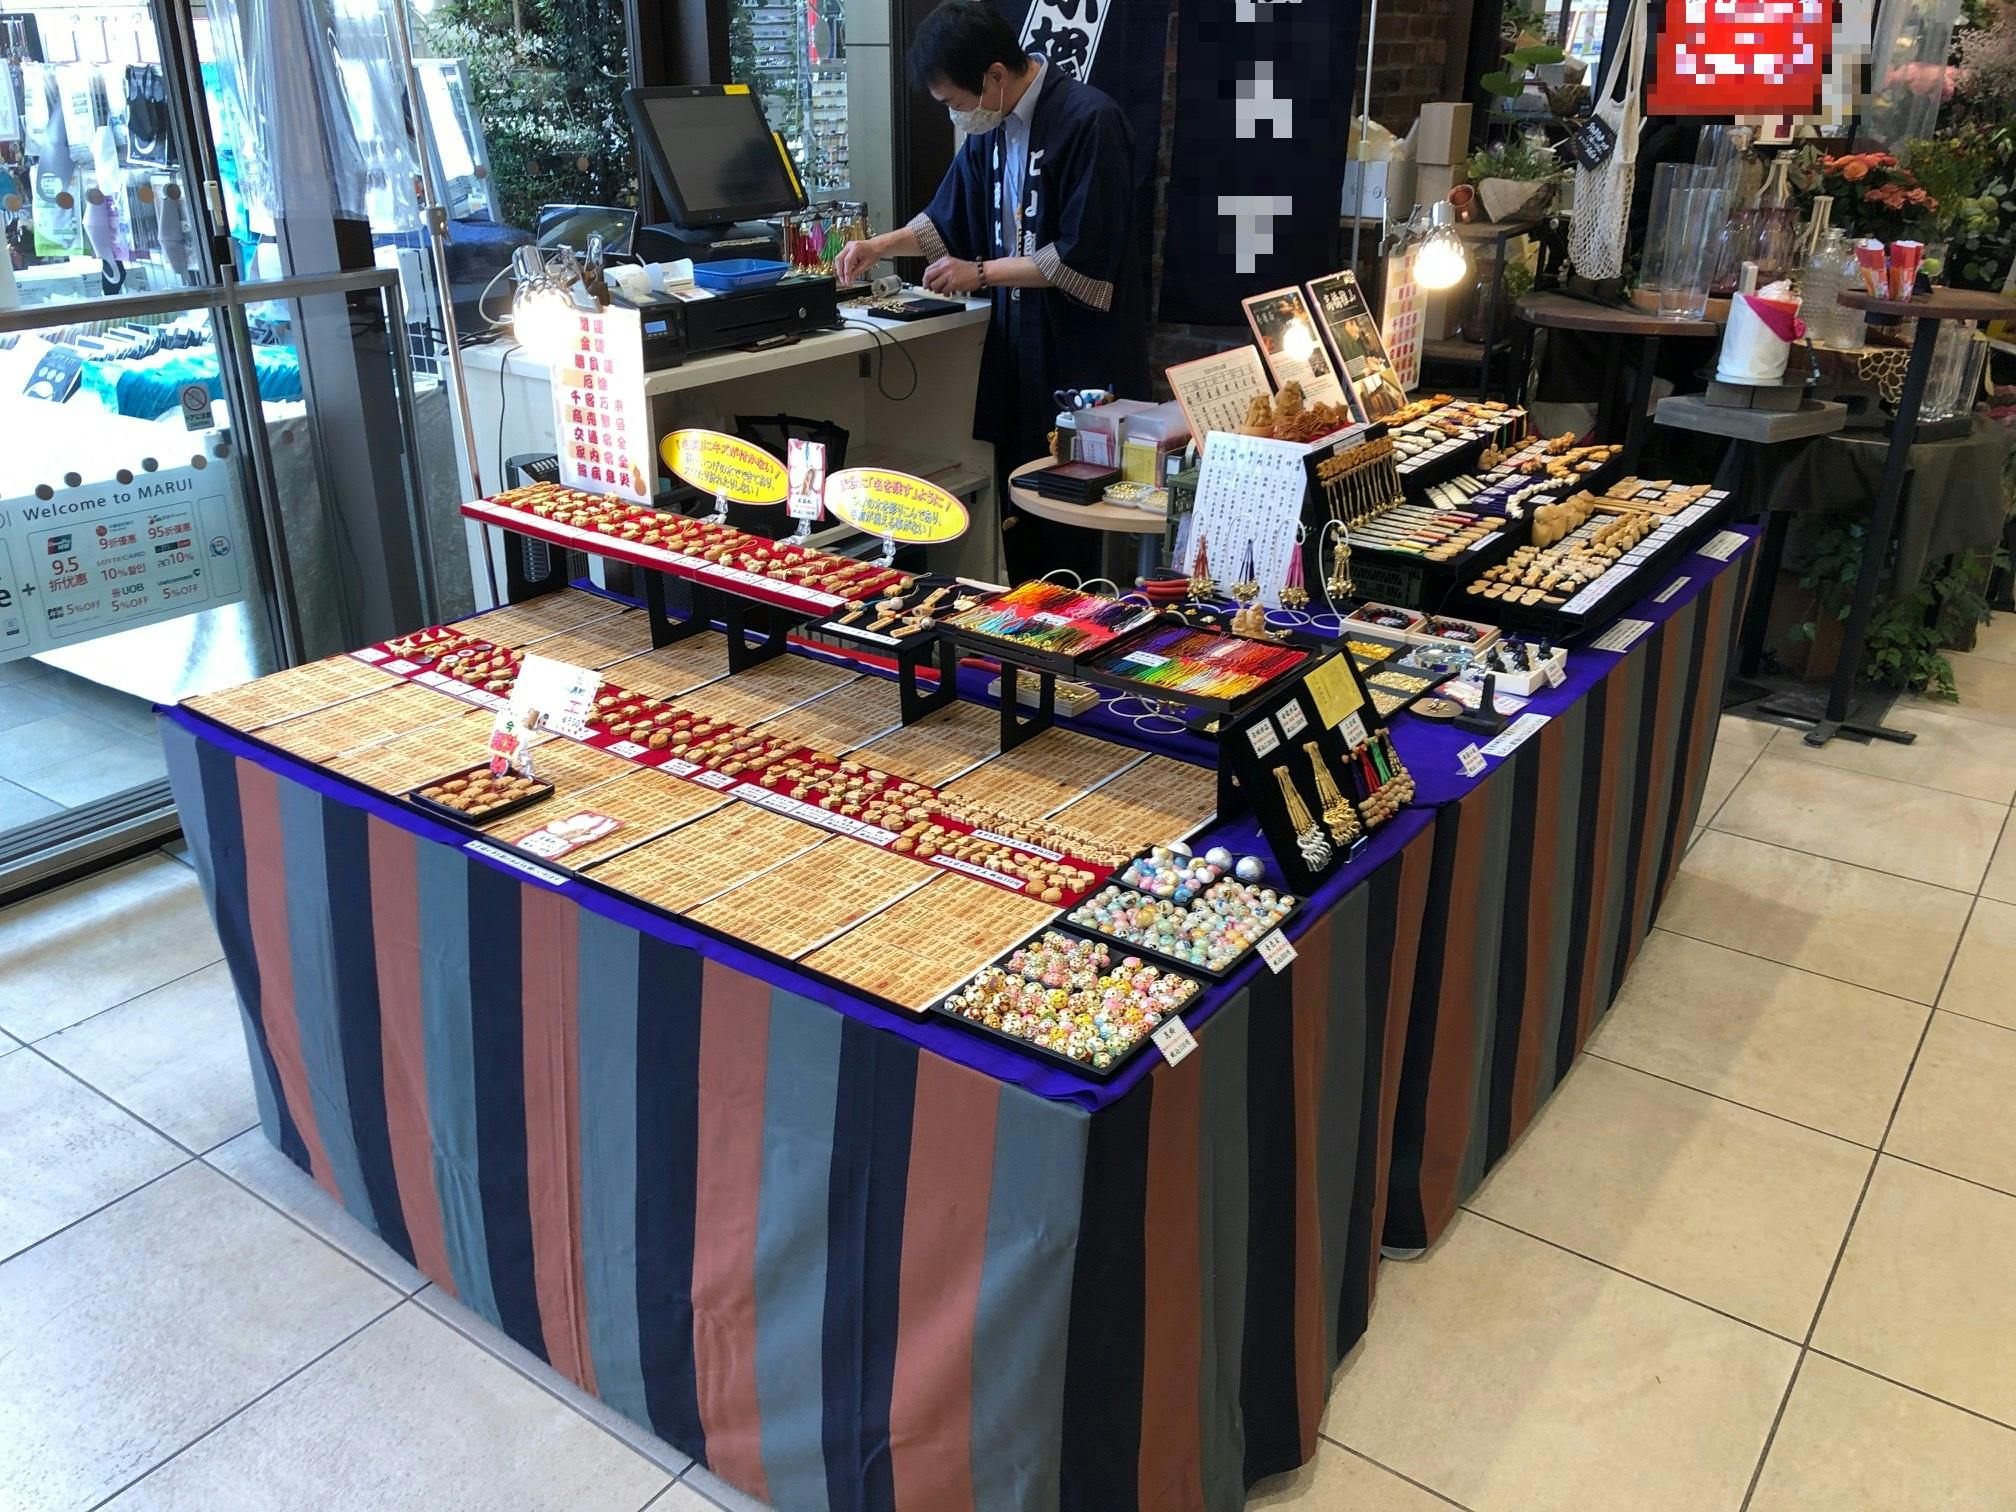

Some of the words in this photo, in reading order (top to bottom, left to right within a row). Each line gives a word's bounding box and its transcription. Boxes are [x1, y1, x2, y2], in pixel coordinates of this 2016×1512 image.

[23, 497, 107, 522] Welcome
[113, 492, 131, 504] to
[138, 479, 193, 499] MARUI
[52, 556, 79, 575] 9.5
[48, 573, 89, 592] 折优惠
[121, 582, 145, 595] UOB
